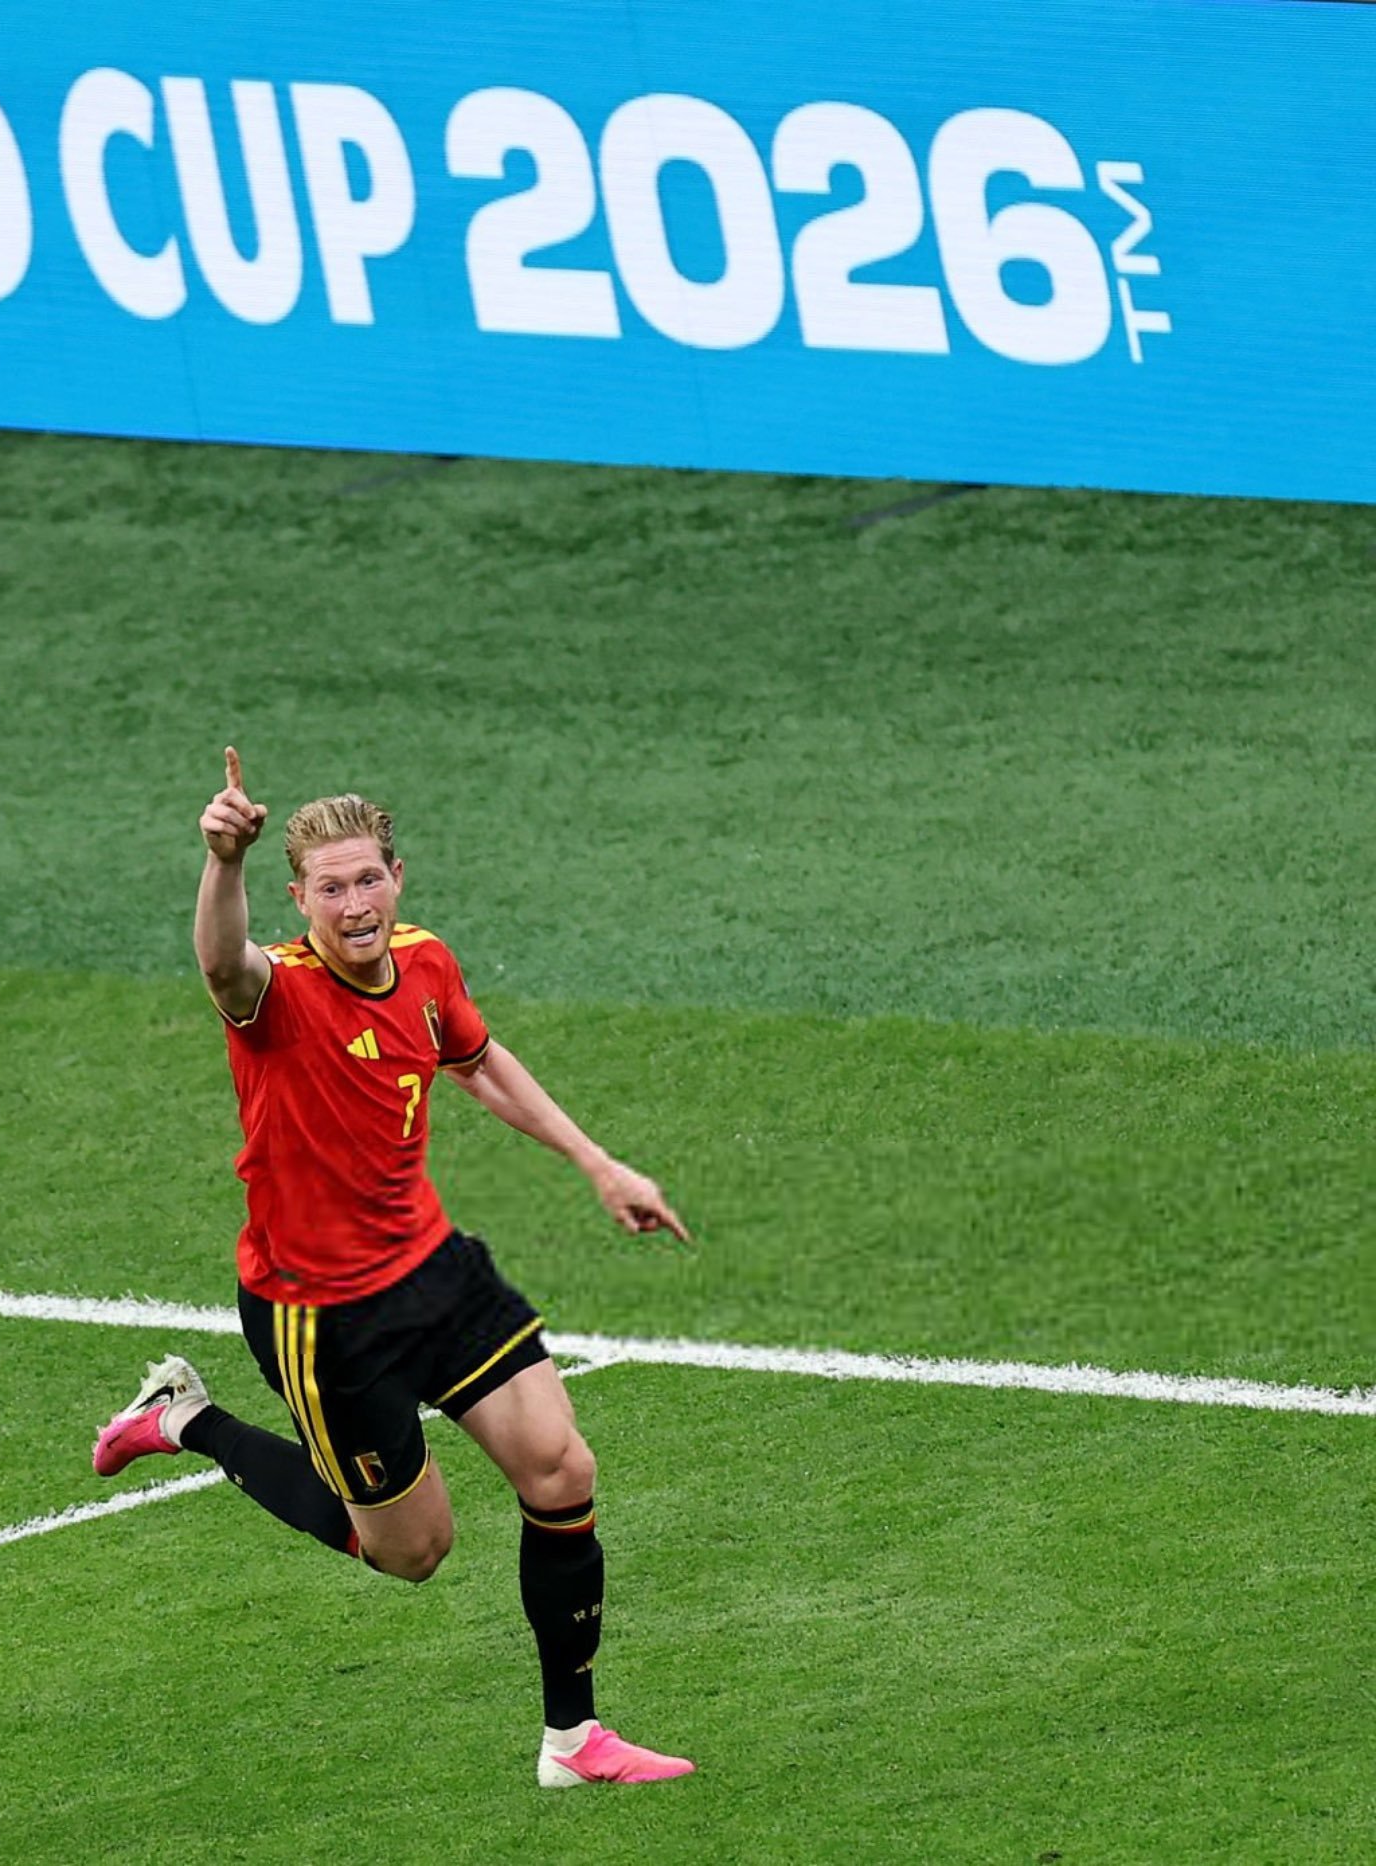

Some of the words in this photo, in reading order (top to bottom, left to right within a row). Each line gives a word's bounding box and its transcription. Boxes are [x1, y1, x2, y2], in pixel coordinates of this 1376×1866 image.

[60, 68, 414, 325] CUP
[446, 88, 1112, 365] 2026
[1096, 160, 1173, 364] TM
[398, 1073, 422, 1138] 7
